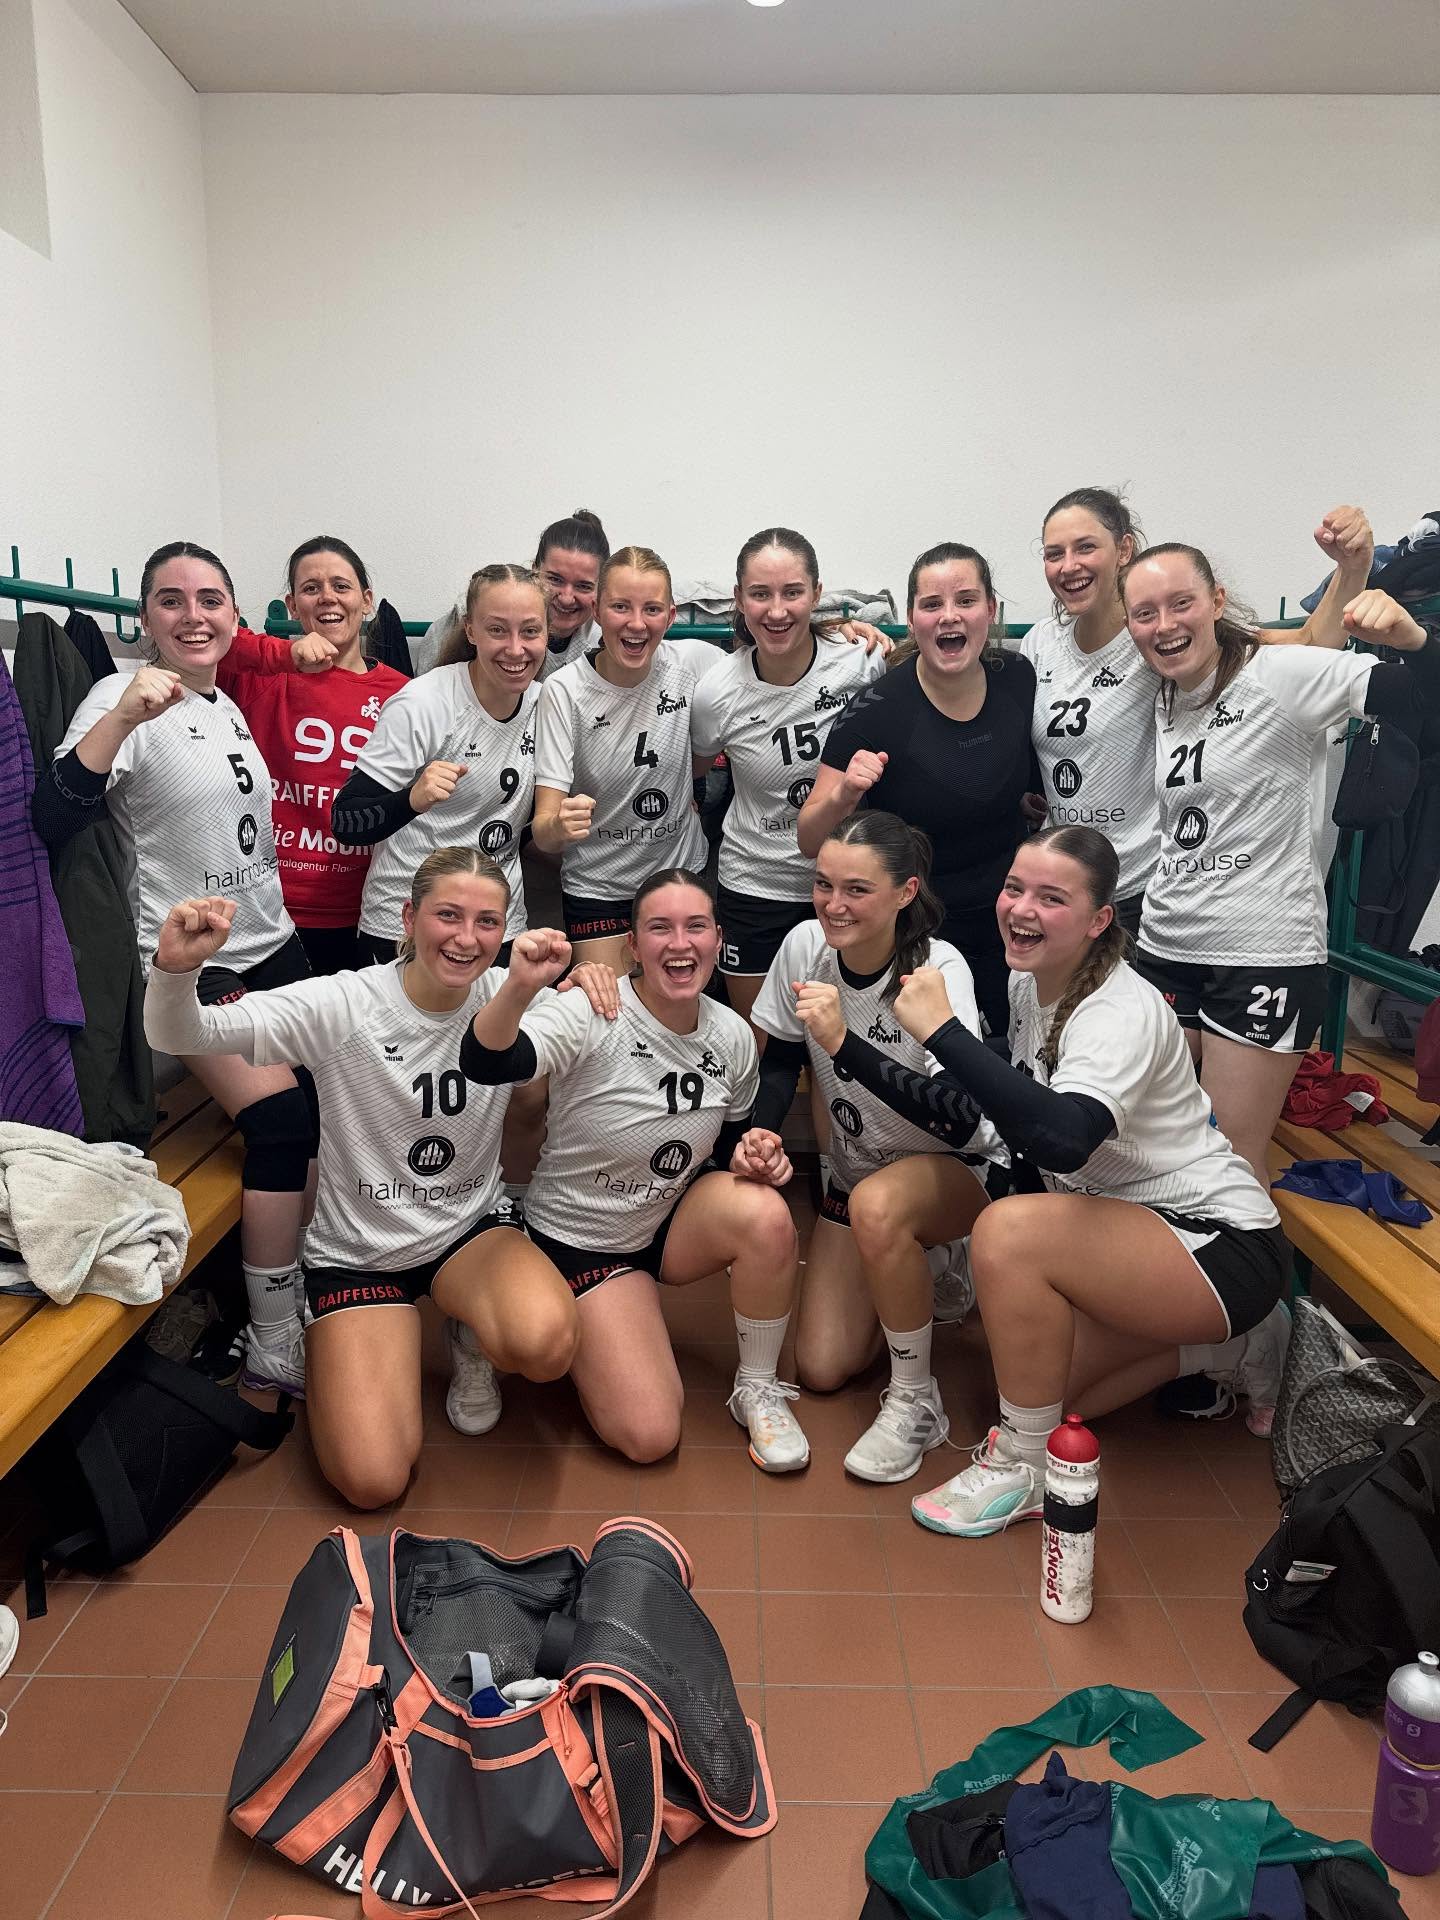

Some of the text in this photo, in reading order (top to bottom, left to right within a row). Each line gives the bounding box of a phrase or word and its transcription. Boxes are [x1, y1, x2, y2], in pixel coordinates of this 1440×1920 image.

[1047, 697, 1091, 738] 23
[634, 731, 659, 769] 4
[771, 722, 820, 767] 15
[1165, 738, 1206, 789] 21
[226, 753, 254, 795] 5
[499, 767, 520, 805] 9
[272, 822, 295, 848] ie
[723, 942, 740, 967] 15
[1246, 984, 1289, 1018] 21
[1245, 1031, 1271, 1041] erima
[411, 1069, 467, 1119] 10
[657, 1071, 705, 1115] 19
[357, 1174, 486, 1203] hairhouse
[265, 1281, 294, 1293] erima
[317, 1285, 404, 1312] RAIFFEISEN
